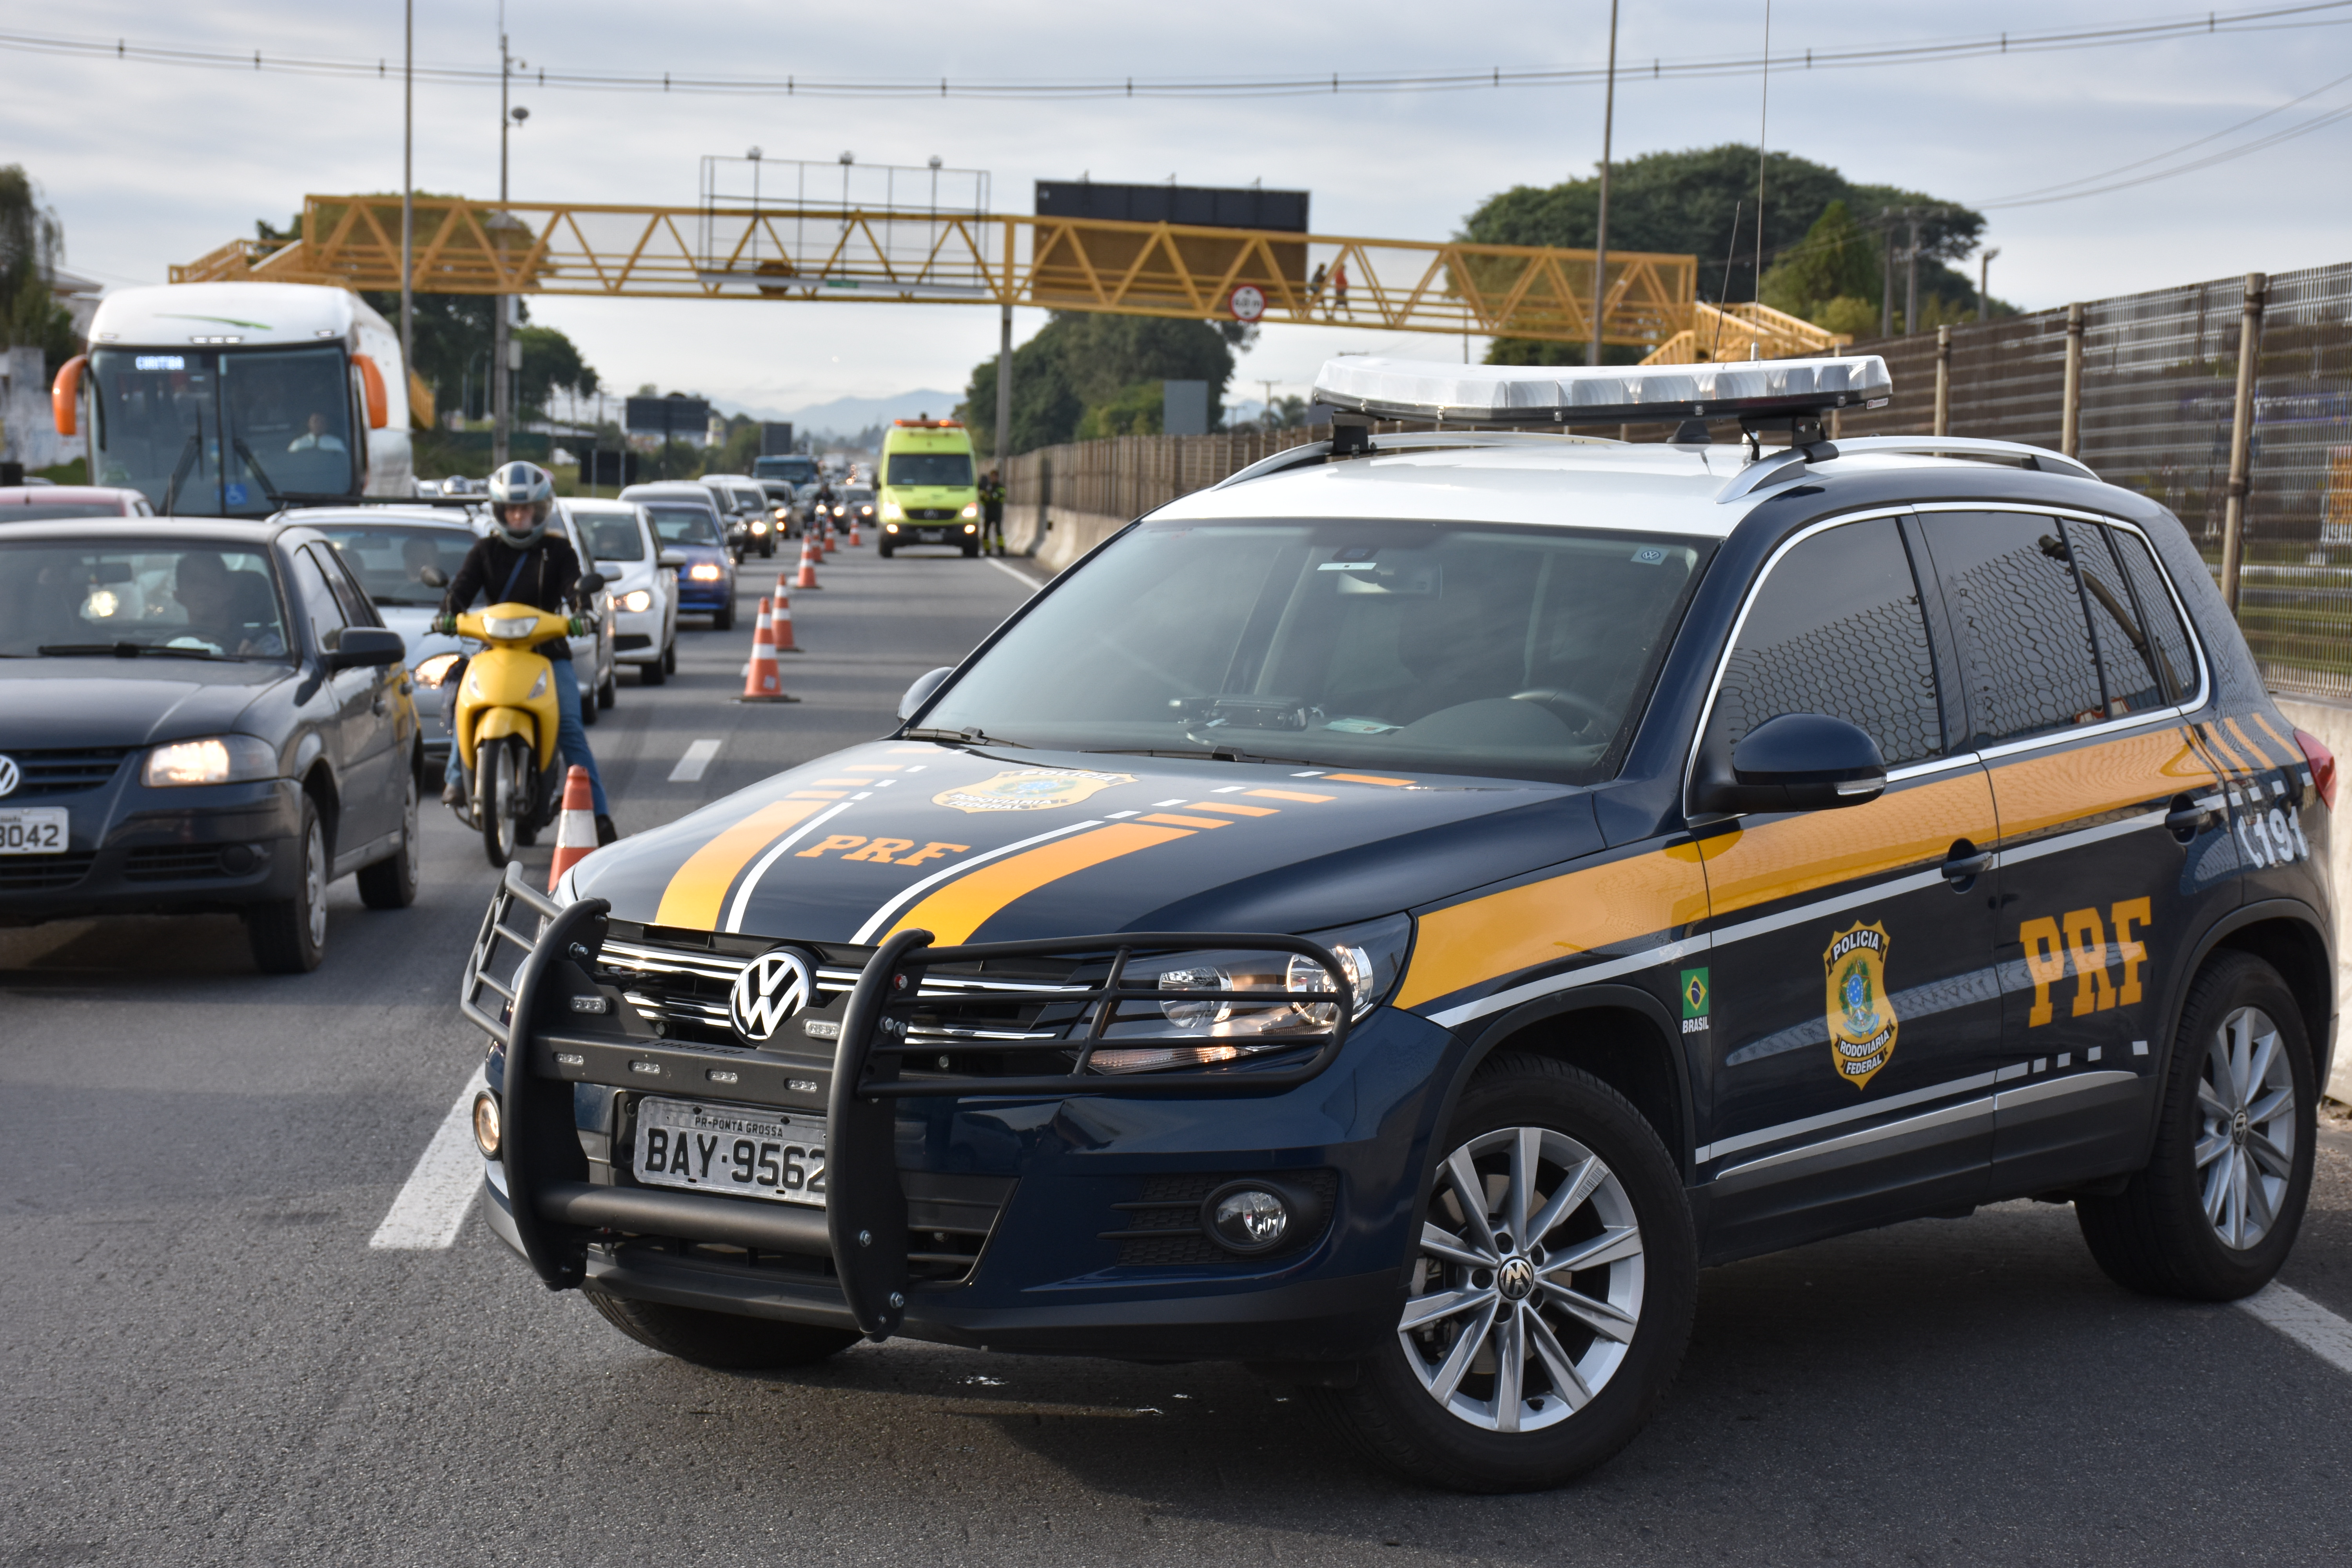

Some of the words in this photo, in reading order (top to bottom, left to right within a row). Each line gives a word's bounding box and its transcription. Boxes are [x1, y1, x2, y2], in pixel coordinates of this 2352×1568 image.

[949, 800, 1022, 809] FEDERAL
[794, 835, 971, 866] PRF
[2019, 896, 2151, 1028] PRF
[1682, 1016, 1709, 1033] BRASIL
[1846, 1054, 1882, 1074] FEDERAL
[695, 1116, 743, 1132] PR-PONTA
[746, 1122, 783, 1137] GROSSA
